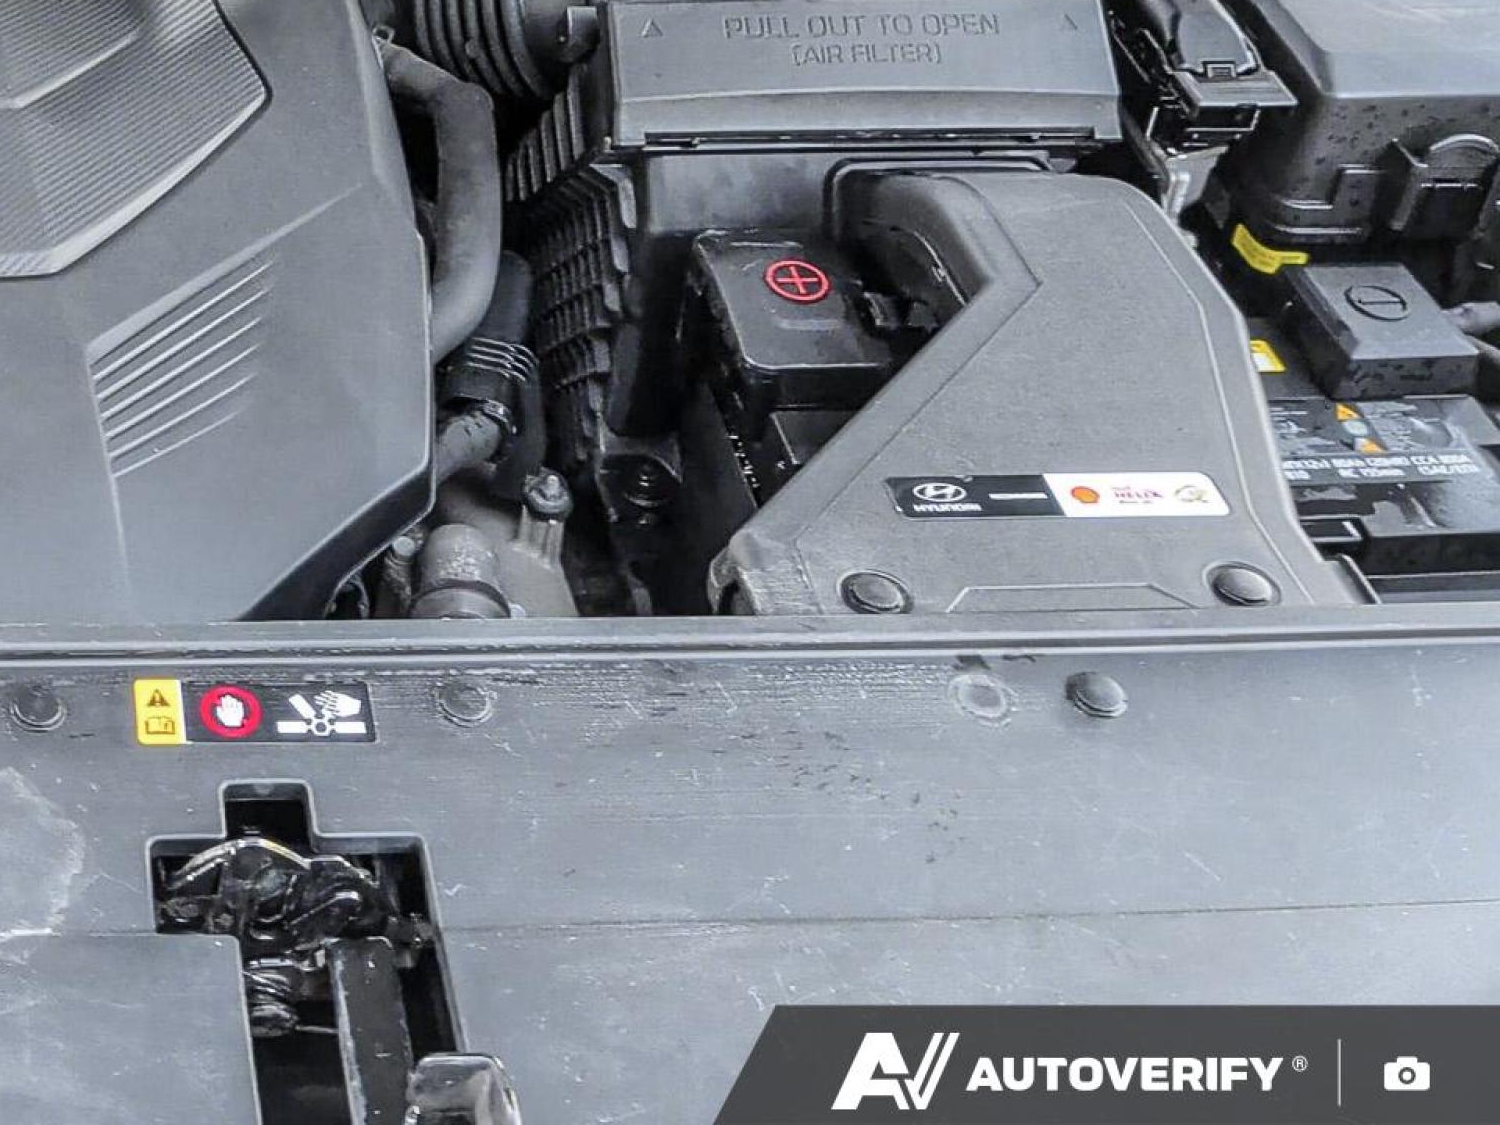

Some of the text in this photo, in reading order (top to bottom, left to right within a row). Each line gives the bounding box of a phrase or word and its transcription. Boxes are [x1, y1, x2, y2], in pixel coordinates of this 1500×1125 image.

[724, 12, 999, 39] PULL OUT TO OPEN
